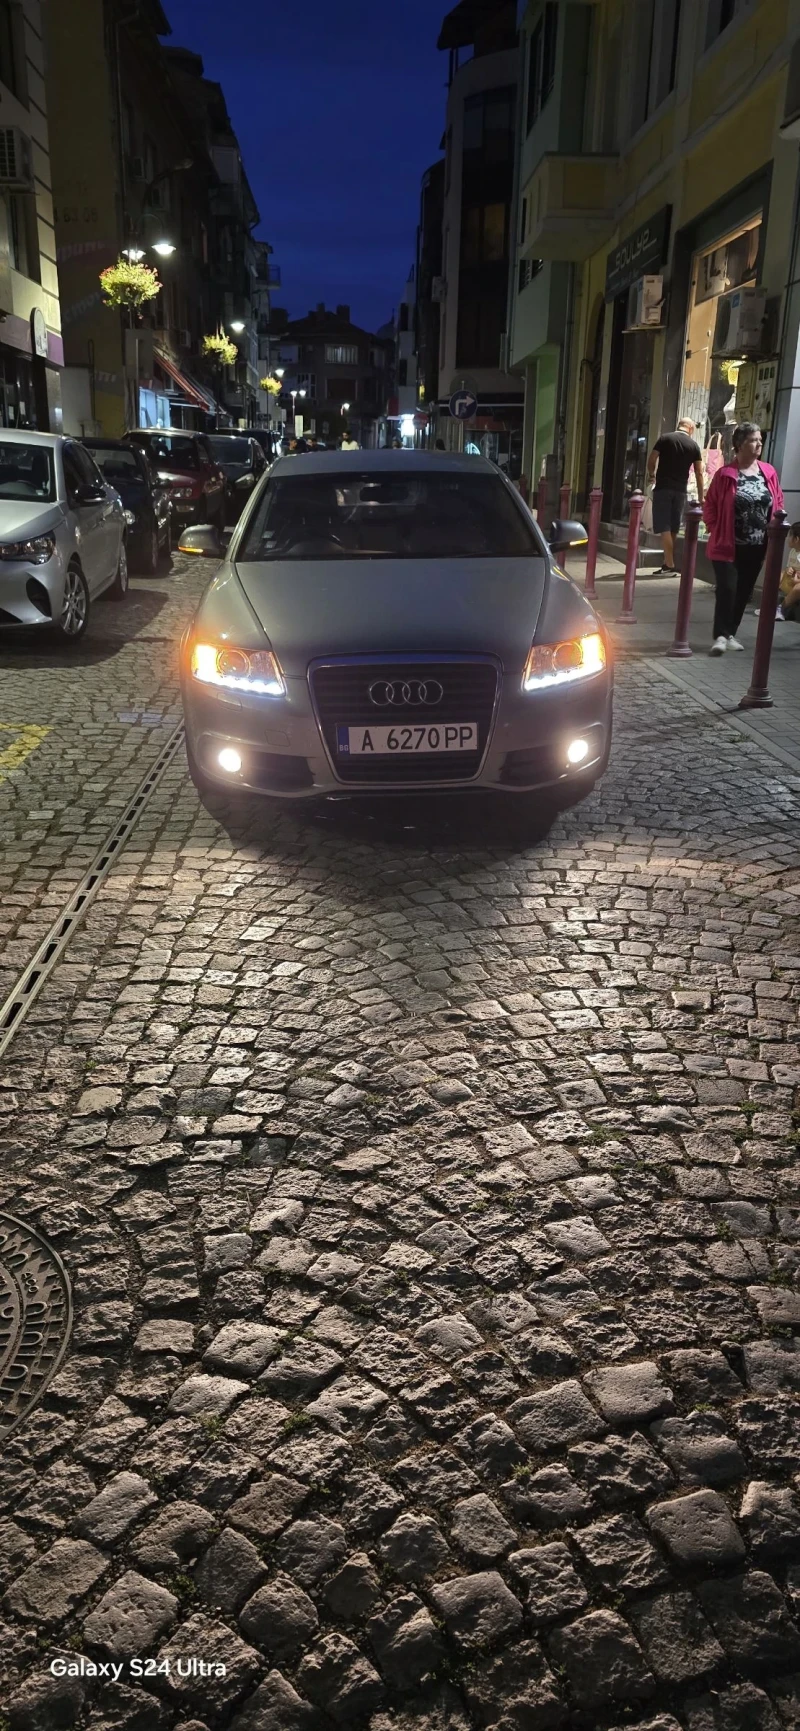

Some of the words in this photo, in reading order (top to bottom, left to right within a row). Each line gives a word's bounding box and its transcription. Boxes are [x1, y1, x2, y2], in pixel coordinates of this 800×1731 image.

[361, 729, 374, 751] A
[386, 727, 440, 750] 6270
[445, 726, 473, 748] PP
